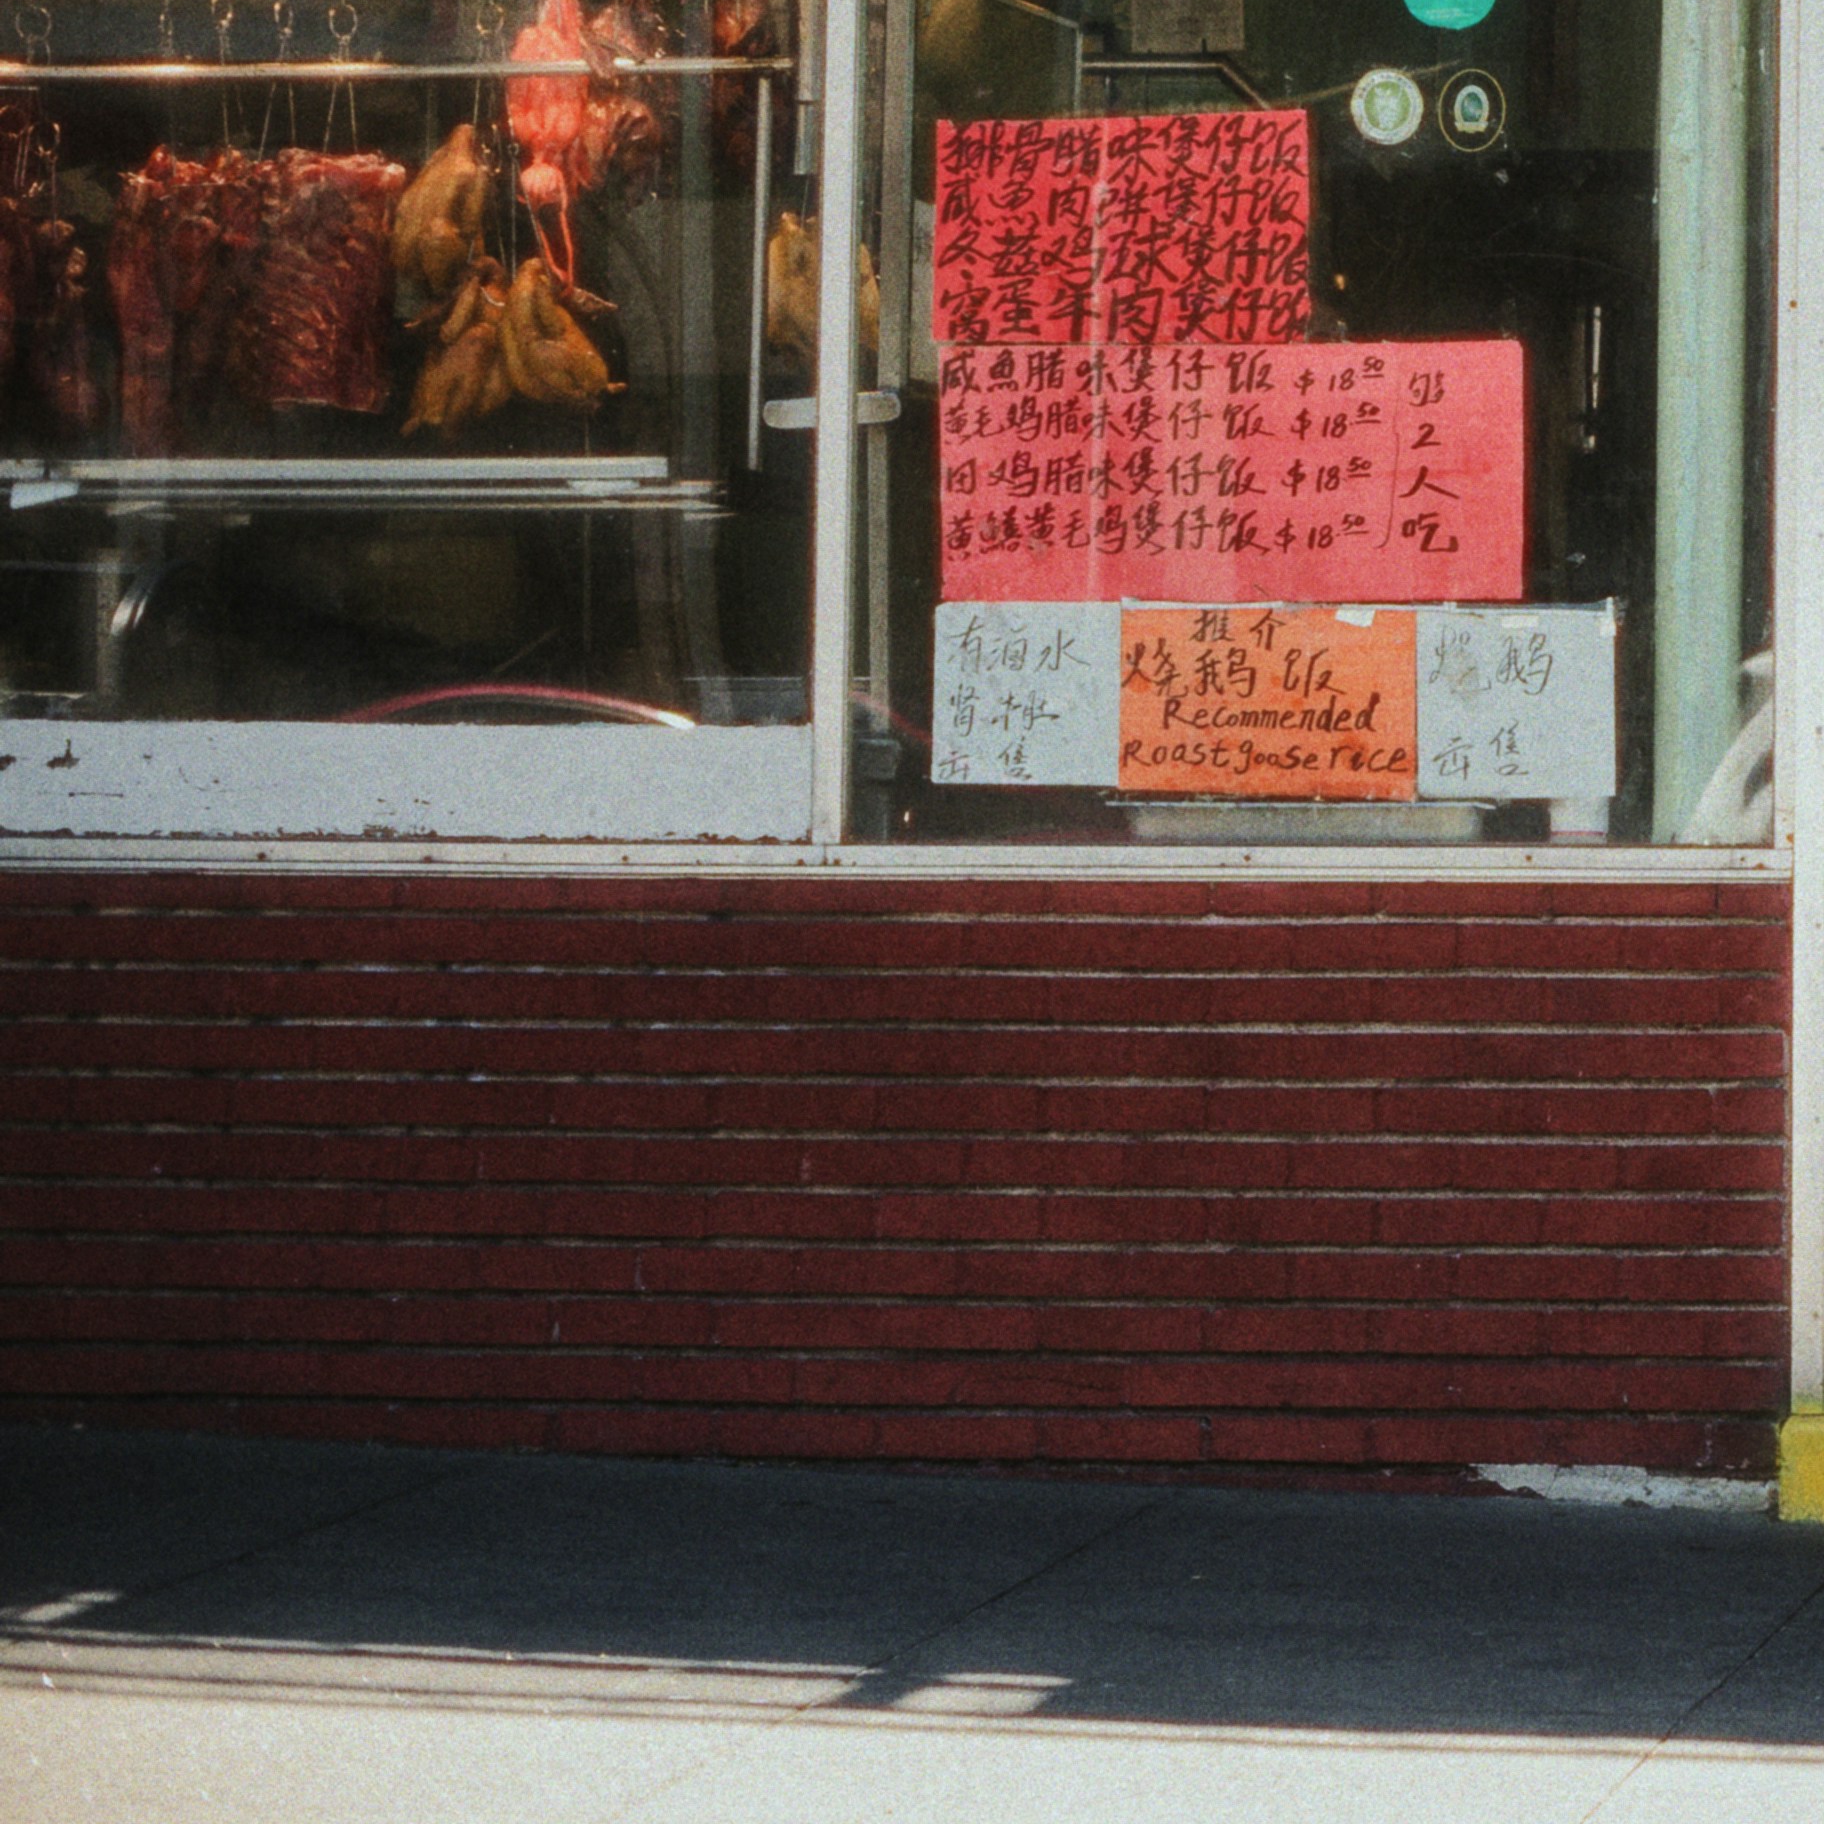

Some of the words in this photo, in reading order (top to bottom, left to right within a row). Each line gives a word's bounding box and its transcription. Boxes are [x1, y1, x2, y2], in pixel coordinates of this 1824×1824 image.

[1163, 693, 1381, 731] Recommended
[1122, 741, 1229, 768] Roast
[1330, 746, 1408, 773] rice
